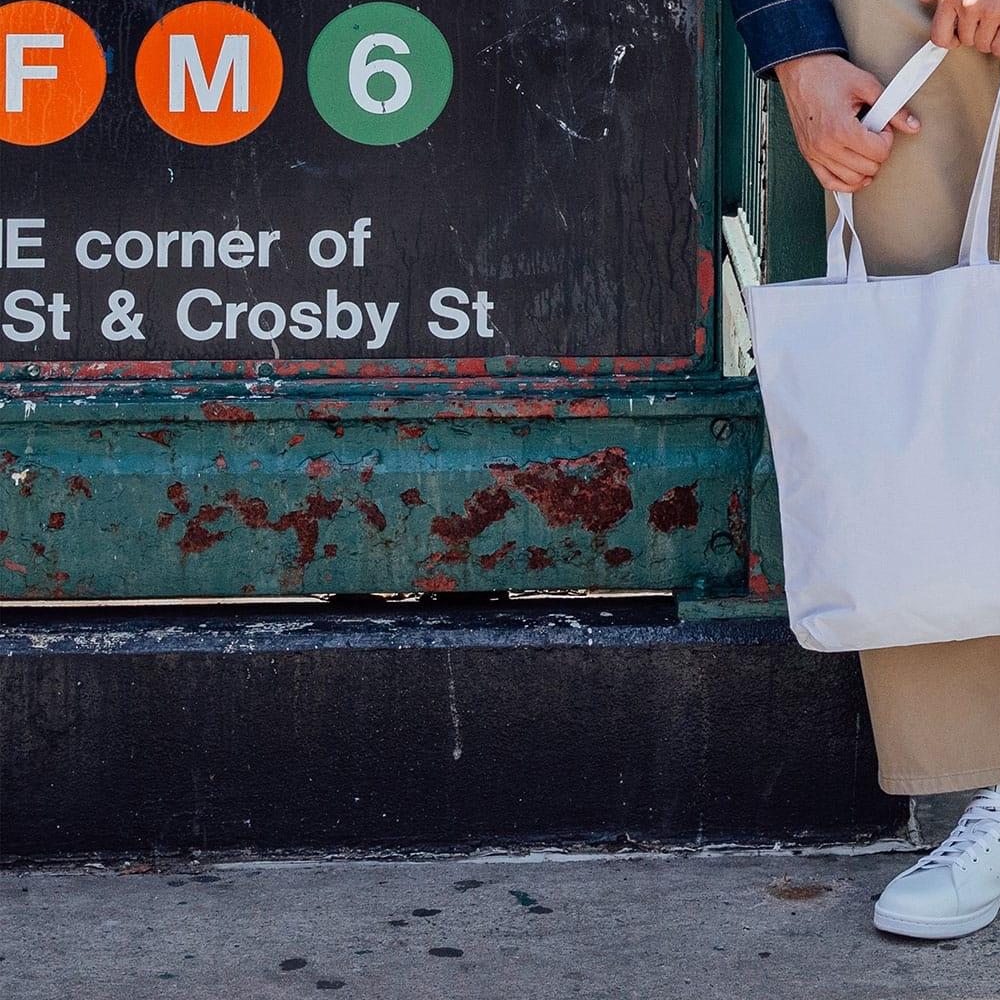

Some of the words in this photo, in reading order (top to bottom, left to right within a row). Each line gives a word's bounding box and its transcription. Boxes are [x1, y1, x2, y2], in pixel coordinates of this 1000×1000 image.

[4, 34, 65, 114] F
[167, 34, 251, 114] M
[347, 32, 414, 116] 6
[75, 229, 281, 270] corner
[308, 217, 372, 269] of
[1, 289, 71, 343] St
[100, 289, 146, 342] &
[176, 287, 400, 350] Crosby
[427, 286, 495, 340] St
